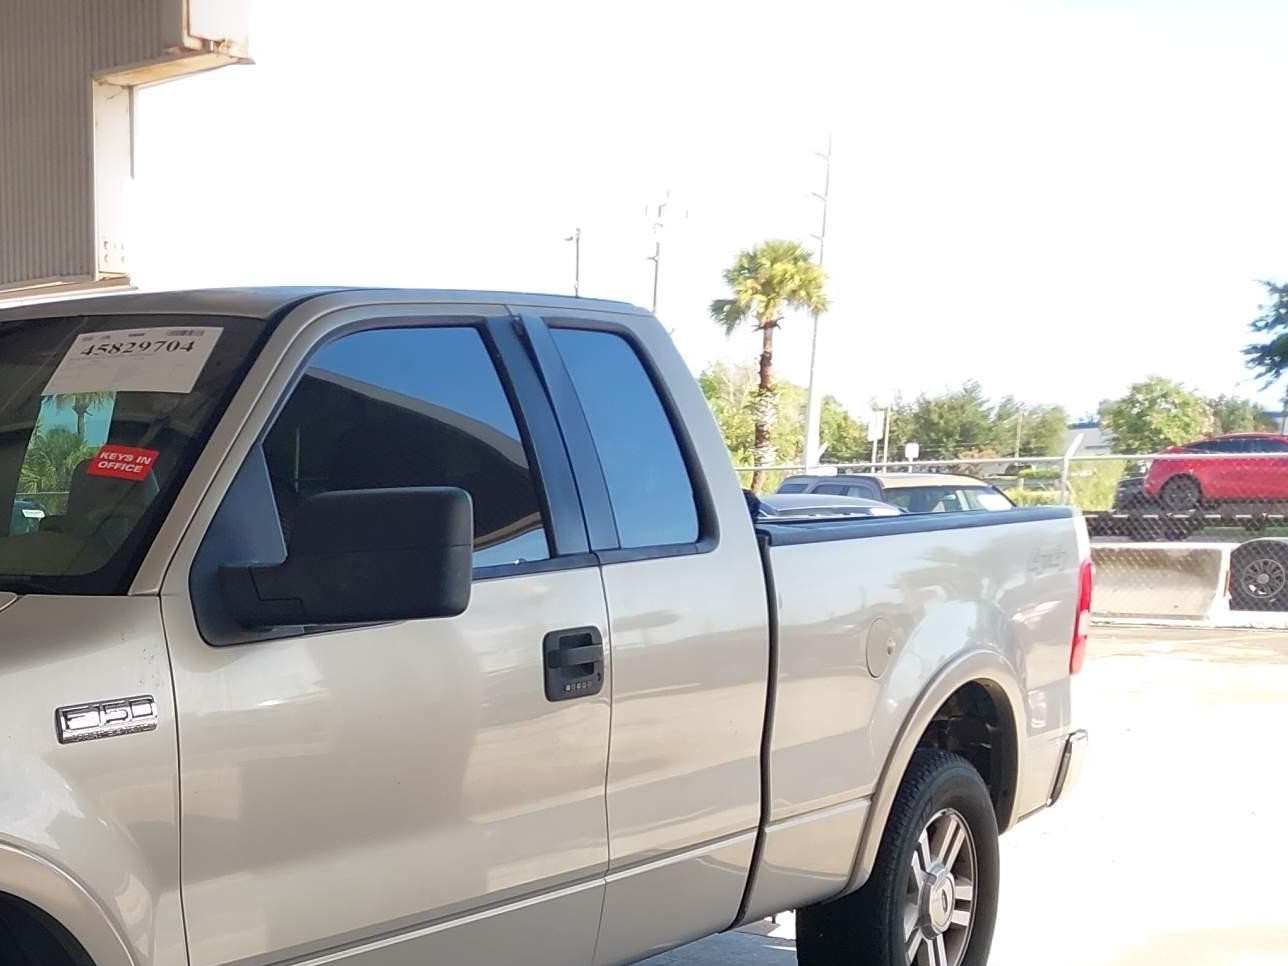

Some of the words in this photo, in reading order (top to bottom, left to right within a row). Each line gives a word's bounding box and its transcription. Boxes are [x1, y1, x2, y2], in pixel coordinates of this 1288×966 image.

[80, 340, 195, 356] 45829704
[99, 451, 134, 462] KEYS
[136, 455, 152, 465] IN
[97, 460, 143, 473] OFFICE
